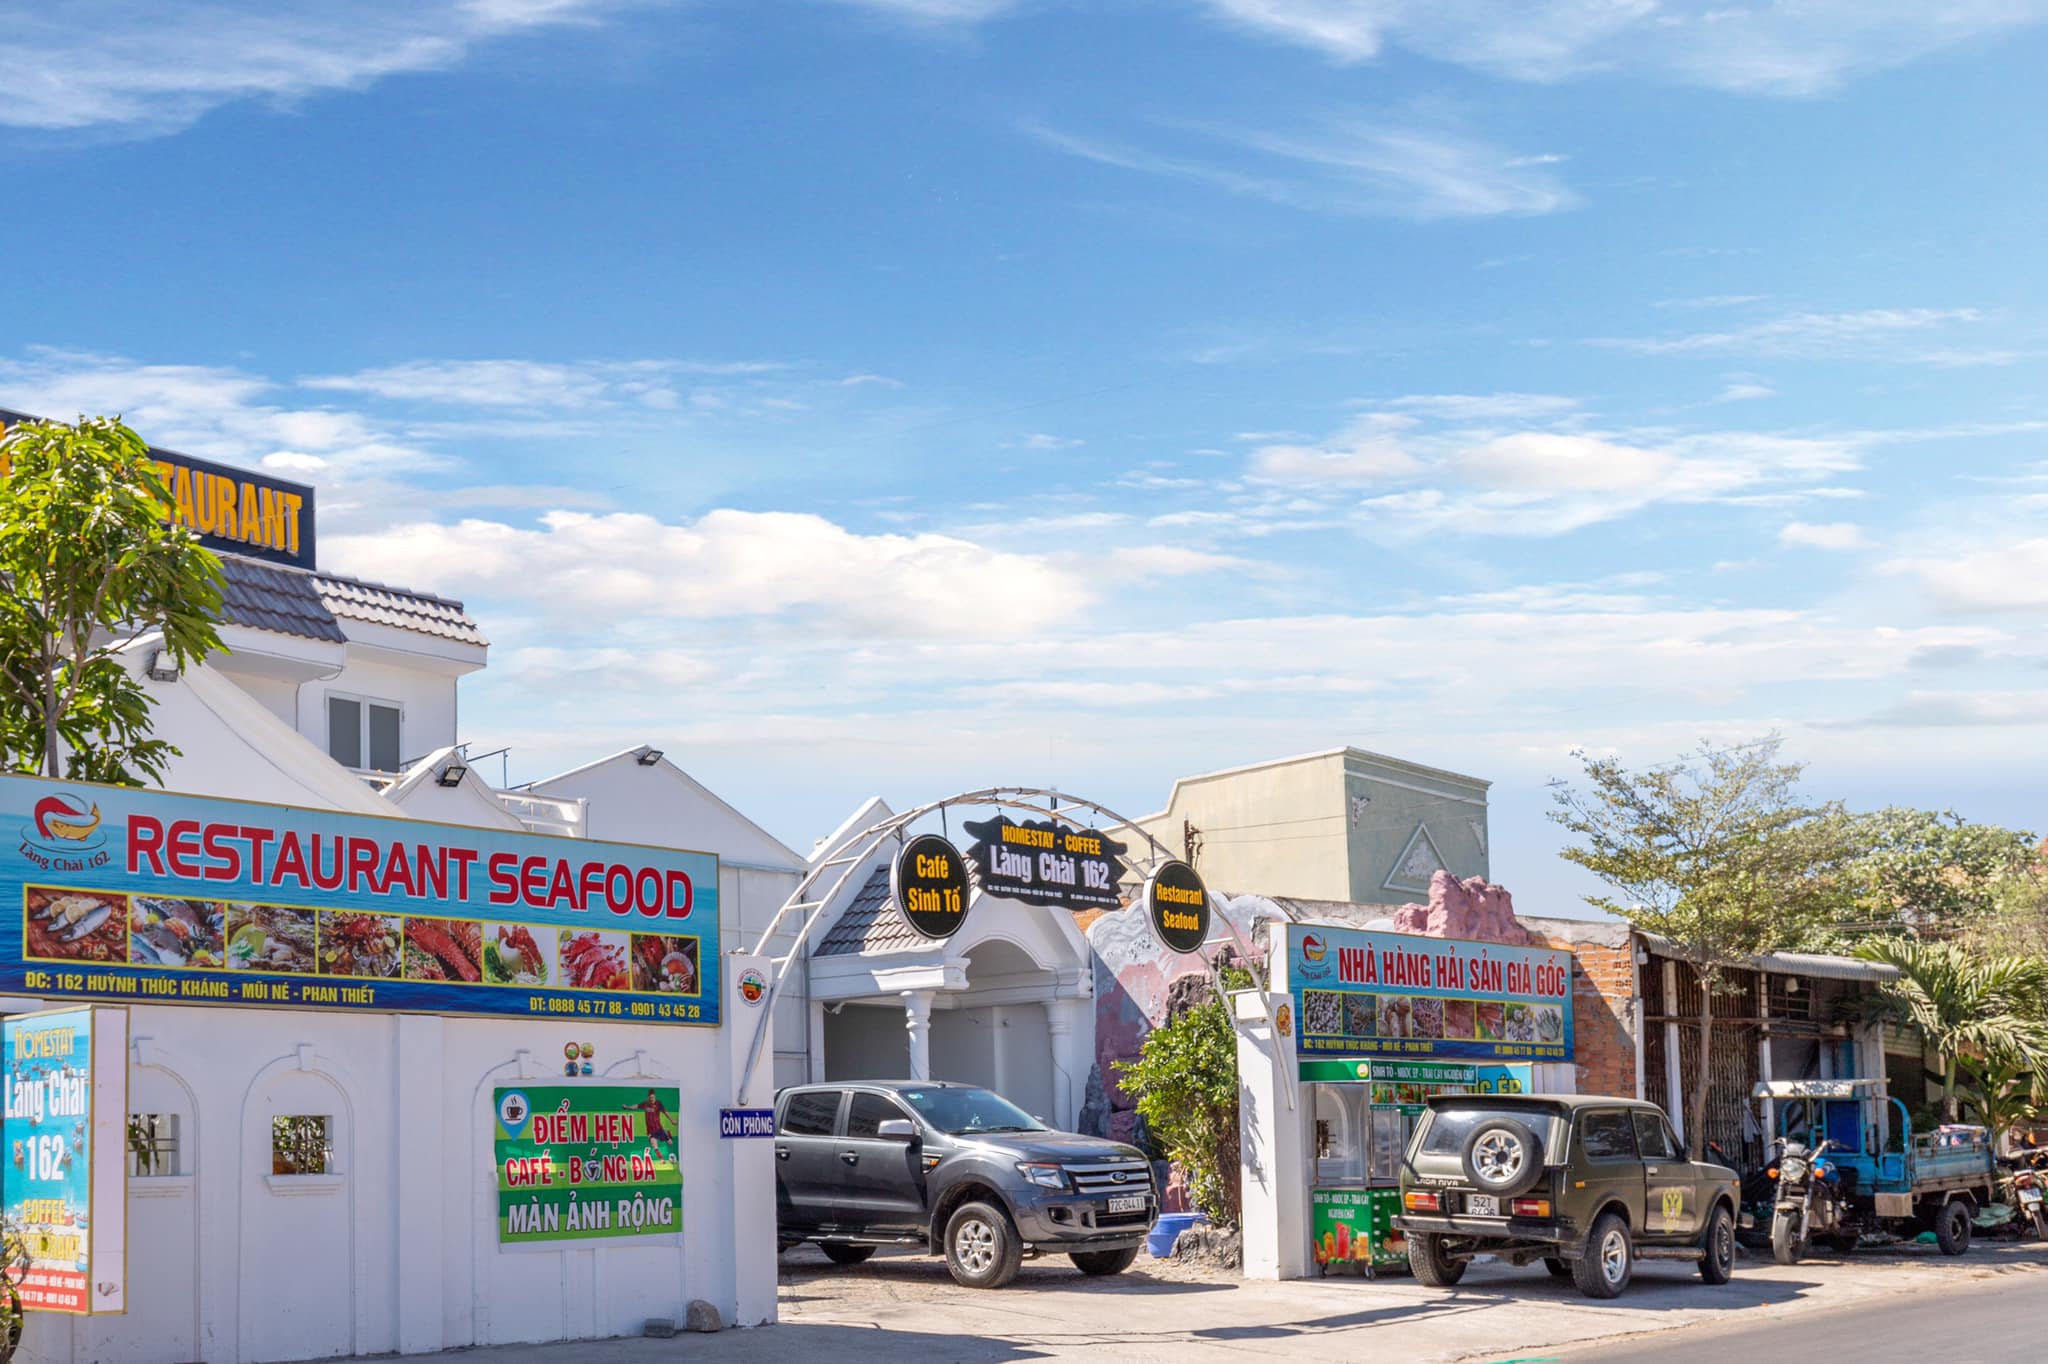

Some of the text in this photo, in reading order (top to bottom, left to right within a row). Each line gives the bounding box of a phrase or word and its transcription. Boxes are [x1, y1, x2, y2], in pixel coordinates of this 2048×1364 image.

[18, 842, 50, 870] Làng
[87, 850, 112, 870] 162
[1001, 824, 1055, 849] HOMESTAY
[1064, 833, 1102, 856] COFFEE
[127, 813, 694, 919] RESTAURANT SEAFOOD
[916, 853, 950, 879] Café
[989, 844, 1111, 890] Làng Chài 162
[908, 886, 941, 912] Sinh
[1156, 882, 1203, 906] Restaurant
[1163, 909, 1199, 931] Seafood
[1338, 941, 1567, 998] NHÀ HÀNG HẢI SẢN GIÁ GỐC
[56, 973, 84, 991] 162
[87, 972, 137, 993] HUỲNH
[141, 975, 177, 995] THÚC
[181, 977, 229, 998] KHÁNG
[302, 985, 338, 1003] PHAN
[341, 983, 375, 1004] THIẾT
[549, 998, 575, 1013] 0888
[577, 999, 591, 1014] 45
[593, 1000, 607, 1014] 77
[609, 1001, 622, 1015] 88
[631, 1002, 656, 1016] 0901
[658, 1004, 671, 1017] 43
[673, 1005, 686, 1018] 45
[687, 1005, 701, 1019] 28
[15, 1026, 76, 1060] HOMESTAY
[4, 1067, 87, 1124] Làng Chài
[533, 1098, 635, 1150] ĐIỂM HẸN
[722, 1111, 773, 1135] CÒN PHÒNG
[26, 1134, 65, 1182] 162
[505, 1150, 553, 1187] CAFÉ
[631, 1148, 656, 1182] ĐÁ
[22, 1198, 65, 1225] COFFEE
[507, 1190, 673, 1234] MÀN ẢNH RỘNG
